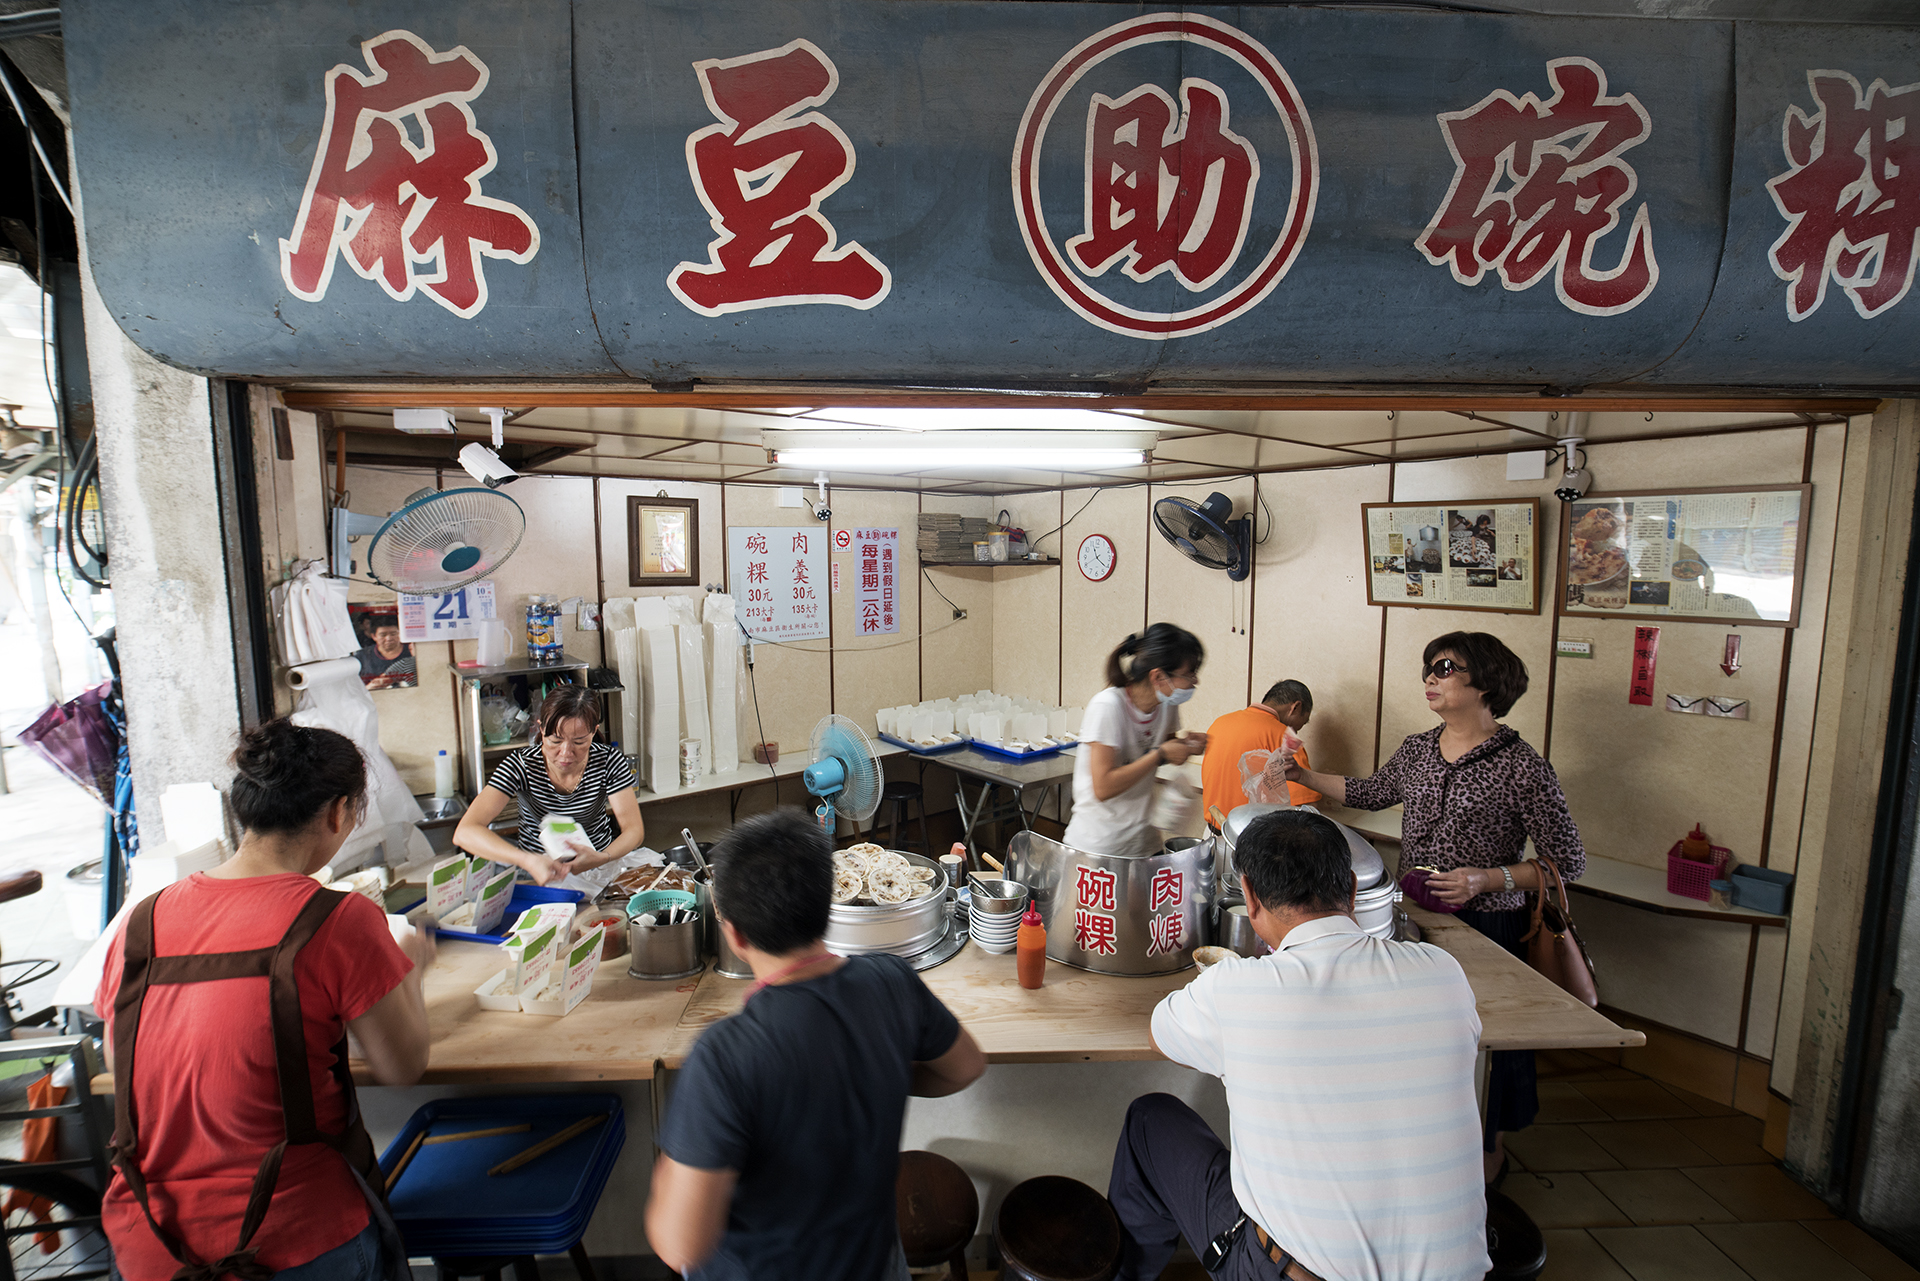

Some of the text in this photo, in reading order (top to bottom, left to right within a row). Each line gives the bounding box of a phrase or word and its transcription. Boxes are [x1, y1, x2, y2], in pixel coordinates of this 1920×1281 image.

[745, 532, 769, 584] 碗粿
[791, 532, 809, 584] 肉羹
[476, 587, 486, 595] 10
[748, 588, 773, 602] 30元
[792, 586, 816, 600] 30元
[861, 544, 880, 632] 每星期二公休
[433, 587, 470, 620] 21
[791, 603, 818, 614] 135大卡
[746, 606, 775, 617] 213大卡
[433, 621, 472, 629] 星期一
[1075, 864, 1118, 957] 碗粿
